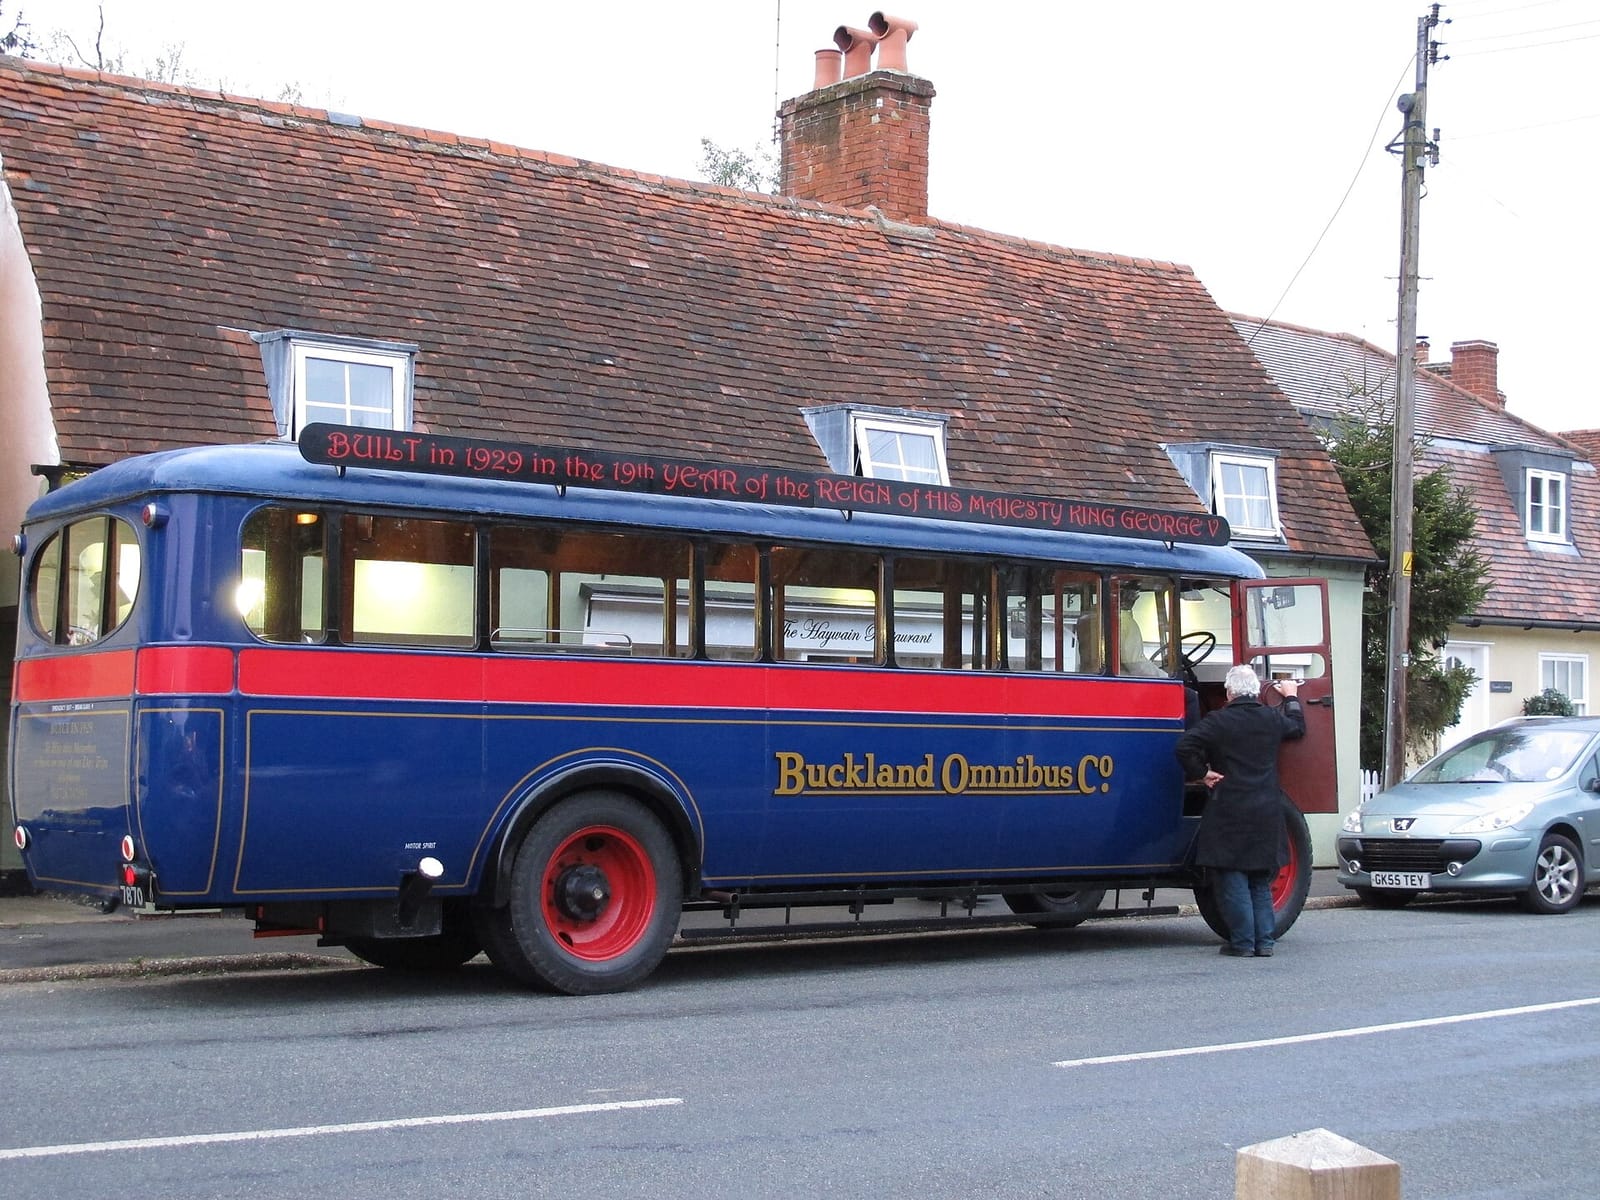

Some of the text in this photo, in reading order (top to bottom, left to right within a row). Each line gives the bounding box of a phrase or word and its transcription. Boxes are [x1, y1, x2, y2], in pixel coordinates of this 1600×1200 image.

[327, 431, 1219, 537] BUILT in 1929 in the 19th YEAR of the REIGN of HIS MAJESTY KING GEORGE V
[800, 618, 861, 648] Haywain
[864, 624, 933, 644] Raurant
[774, 752, 935, 795] Buckland
[942, 753, 1074, 795] Omnibus
[120, 885, 143, 905] 7870
[1375, 874, 1423, 886] GK55 TEY
